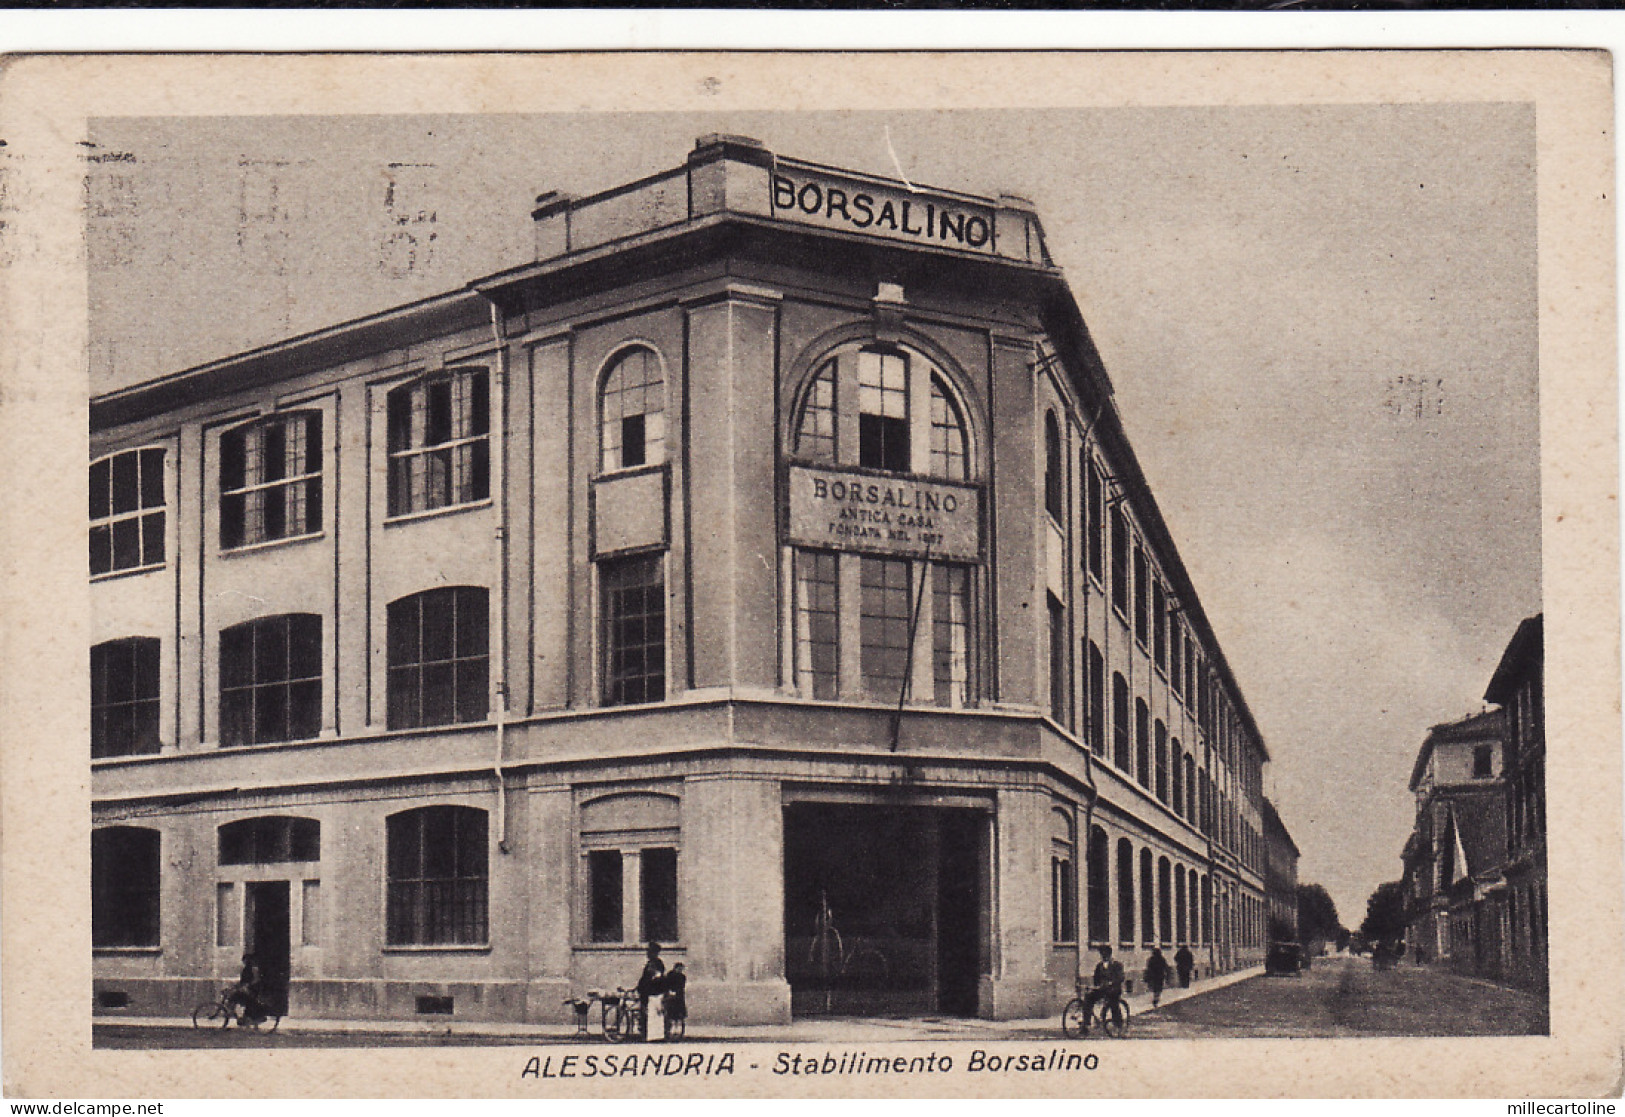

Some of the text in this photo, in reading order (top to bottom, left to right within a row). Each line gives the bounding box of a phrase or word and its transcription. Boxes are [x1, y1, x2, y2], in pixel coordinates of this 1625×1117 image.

[773, 174, 989, 247] BORSALINO
[813, 478, 957, 513] BORSALINO
[839, 508, 933, 528] ANTICA CASA
